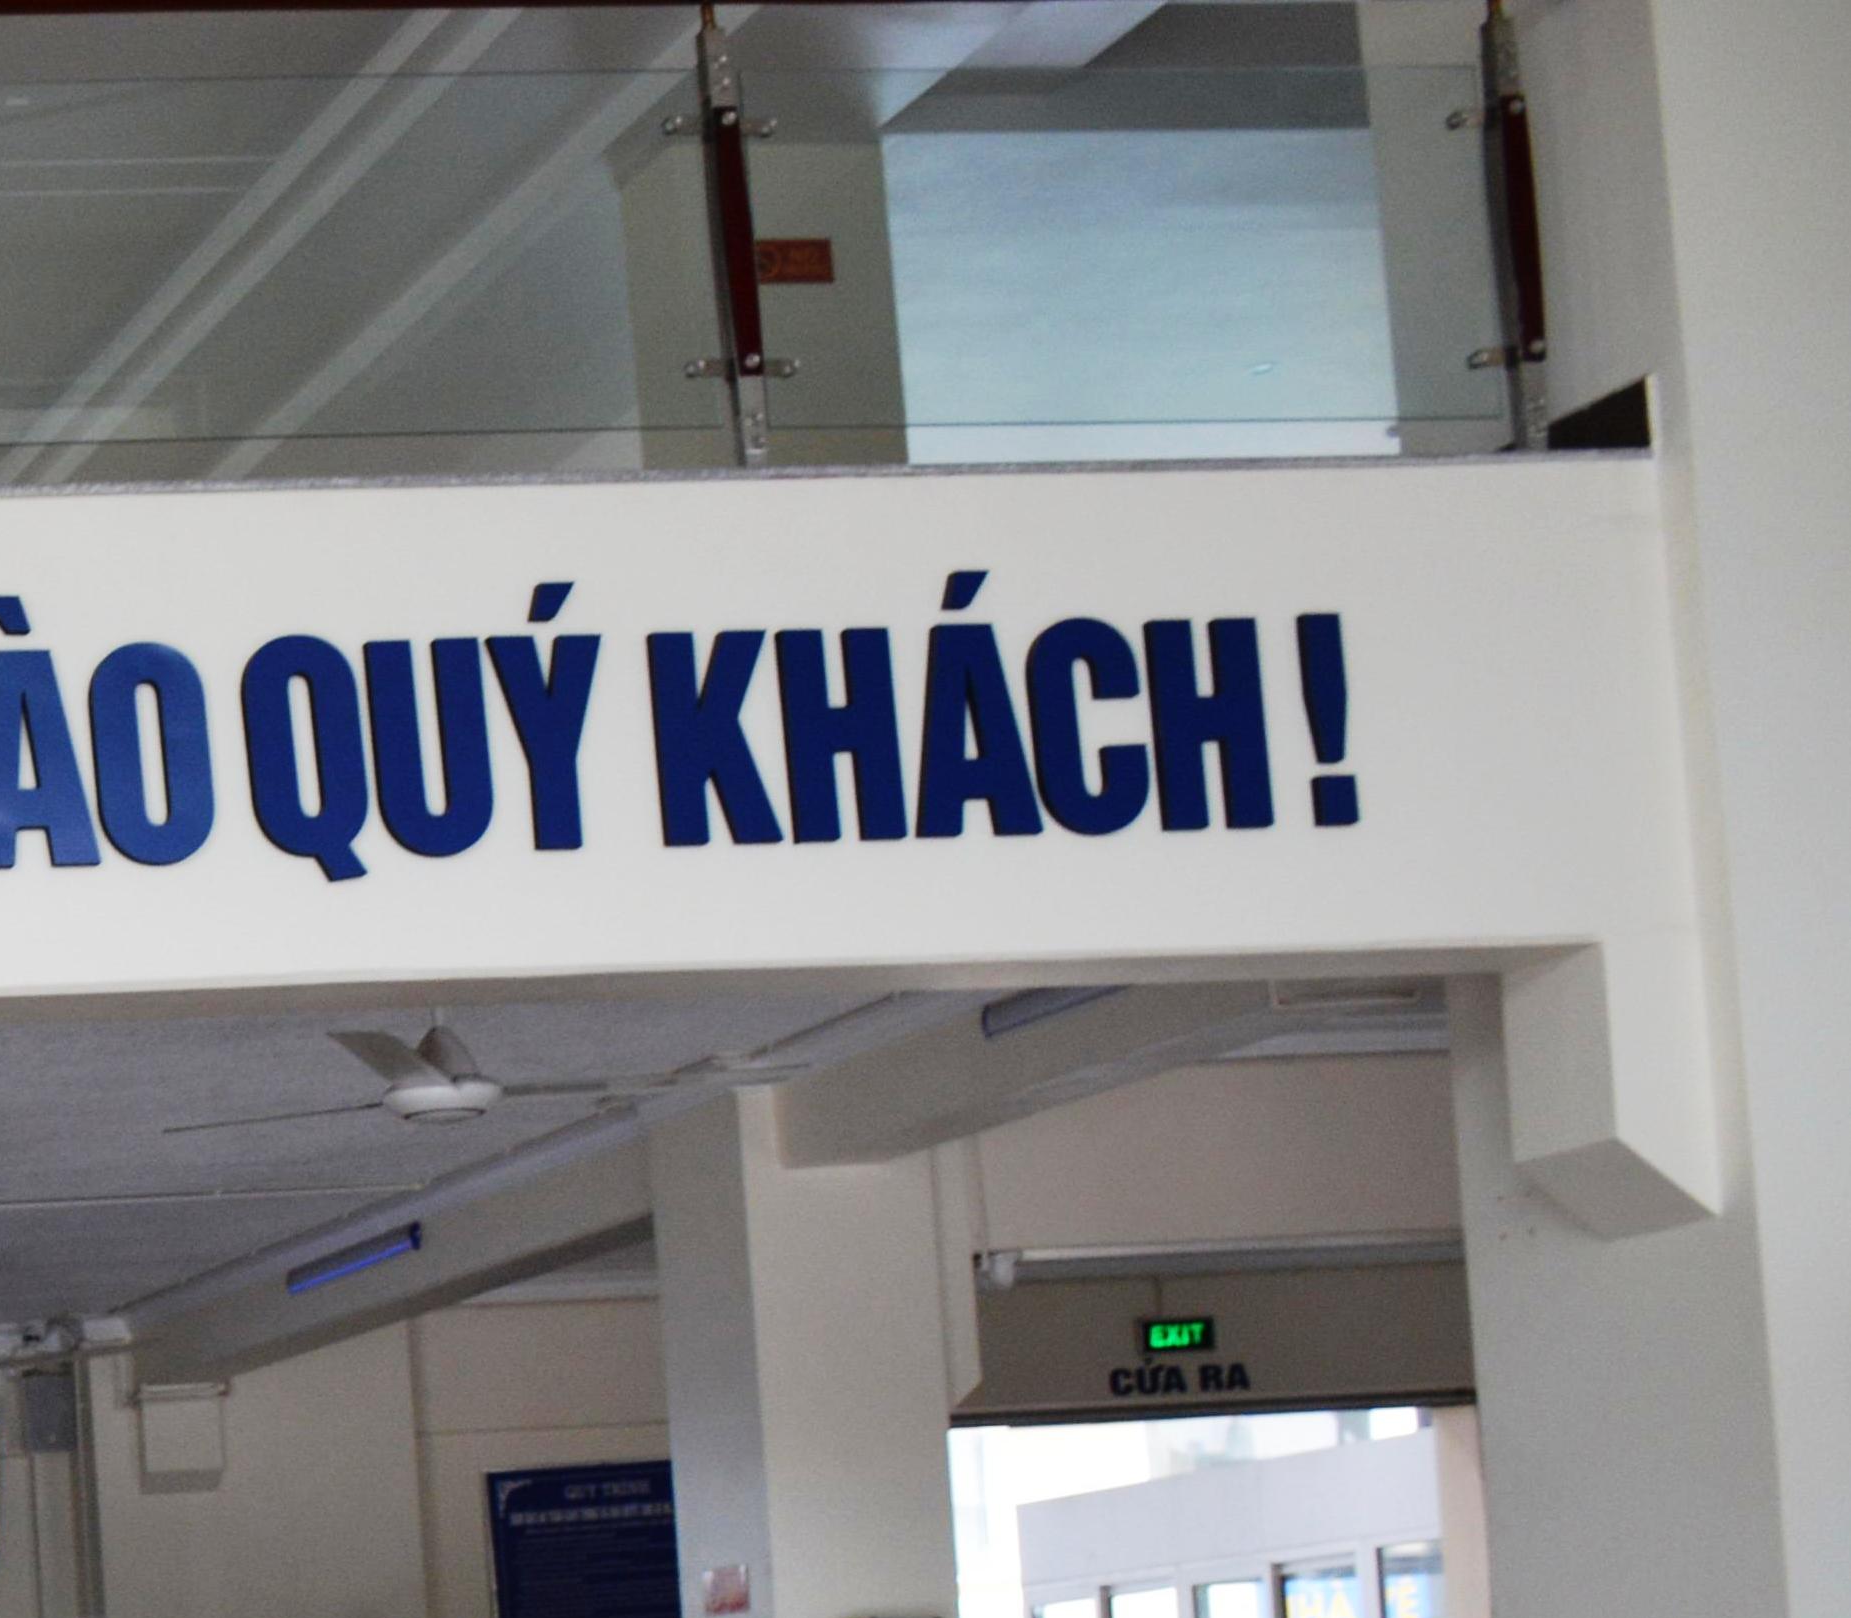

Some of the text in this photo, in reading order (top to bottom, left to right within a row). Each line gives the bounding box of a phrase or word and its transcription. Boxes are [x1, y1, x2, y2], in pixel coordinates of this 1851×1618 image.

[240, 582, 600, 881] QUÝ
[1148, 1322, 1205, 1349] EXIT
[1200, 1363, 1251, 1392] RA
